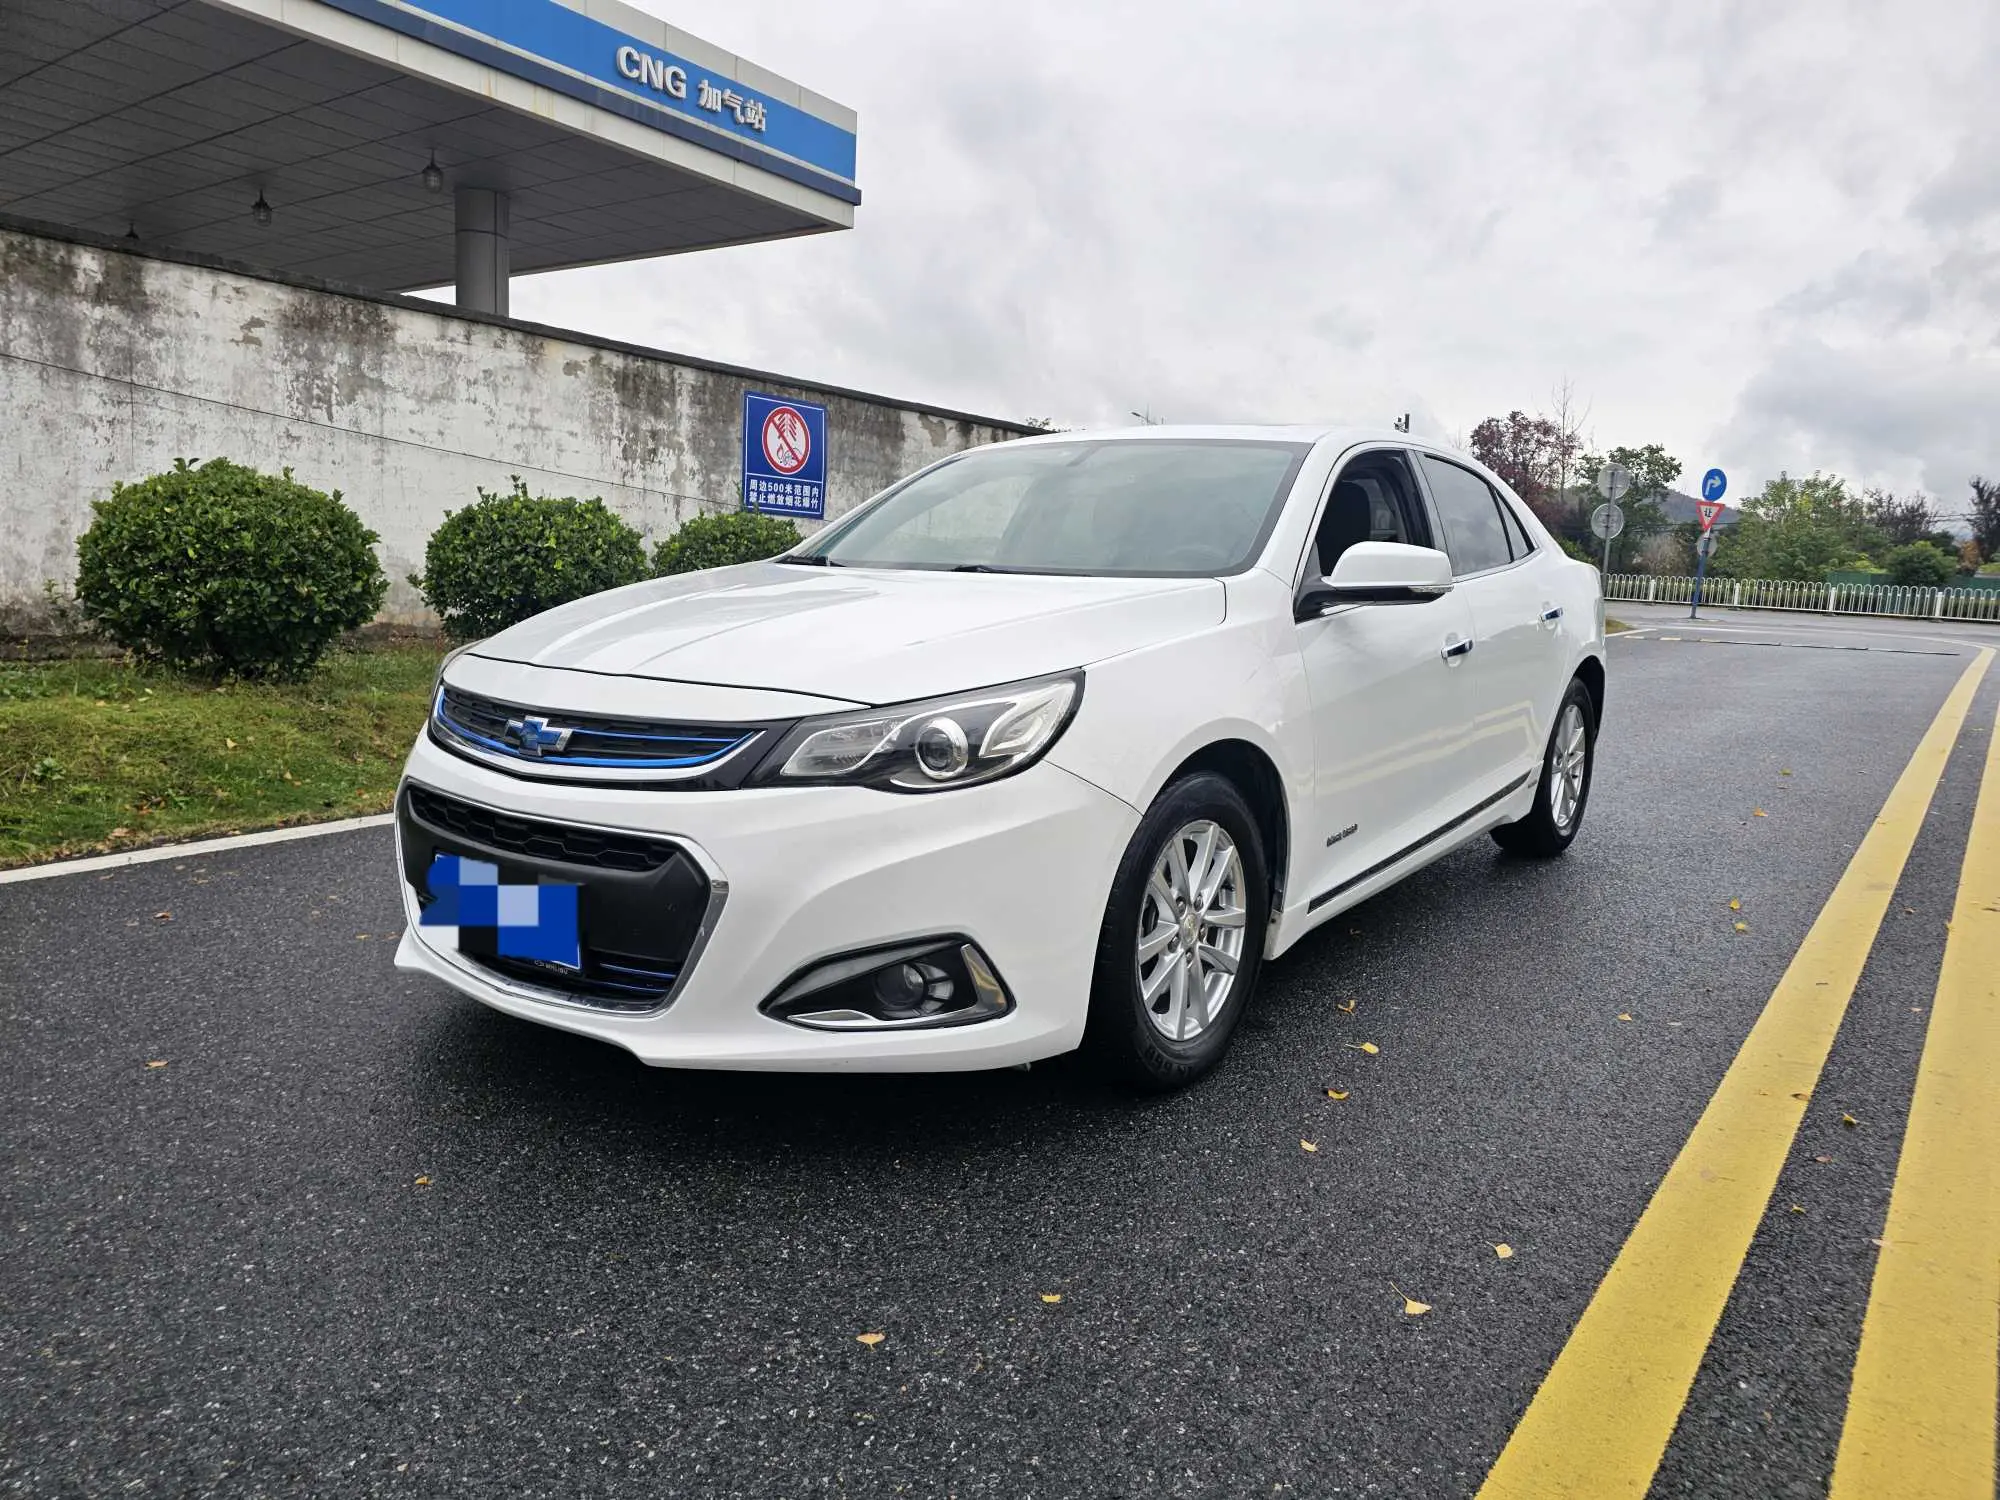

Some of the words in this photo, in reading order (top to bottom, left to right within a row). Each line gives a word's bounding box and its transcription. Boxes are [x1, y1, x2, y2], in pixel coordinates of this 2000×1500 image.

[616, 46, 687, 98] CNG
[698, 79, 767, 132] 加气站
[749, 478, 819, 498] 周边500米范围内
[749, 491, 819, 509] 禁止燃放烟花爆竹
